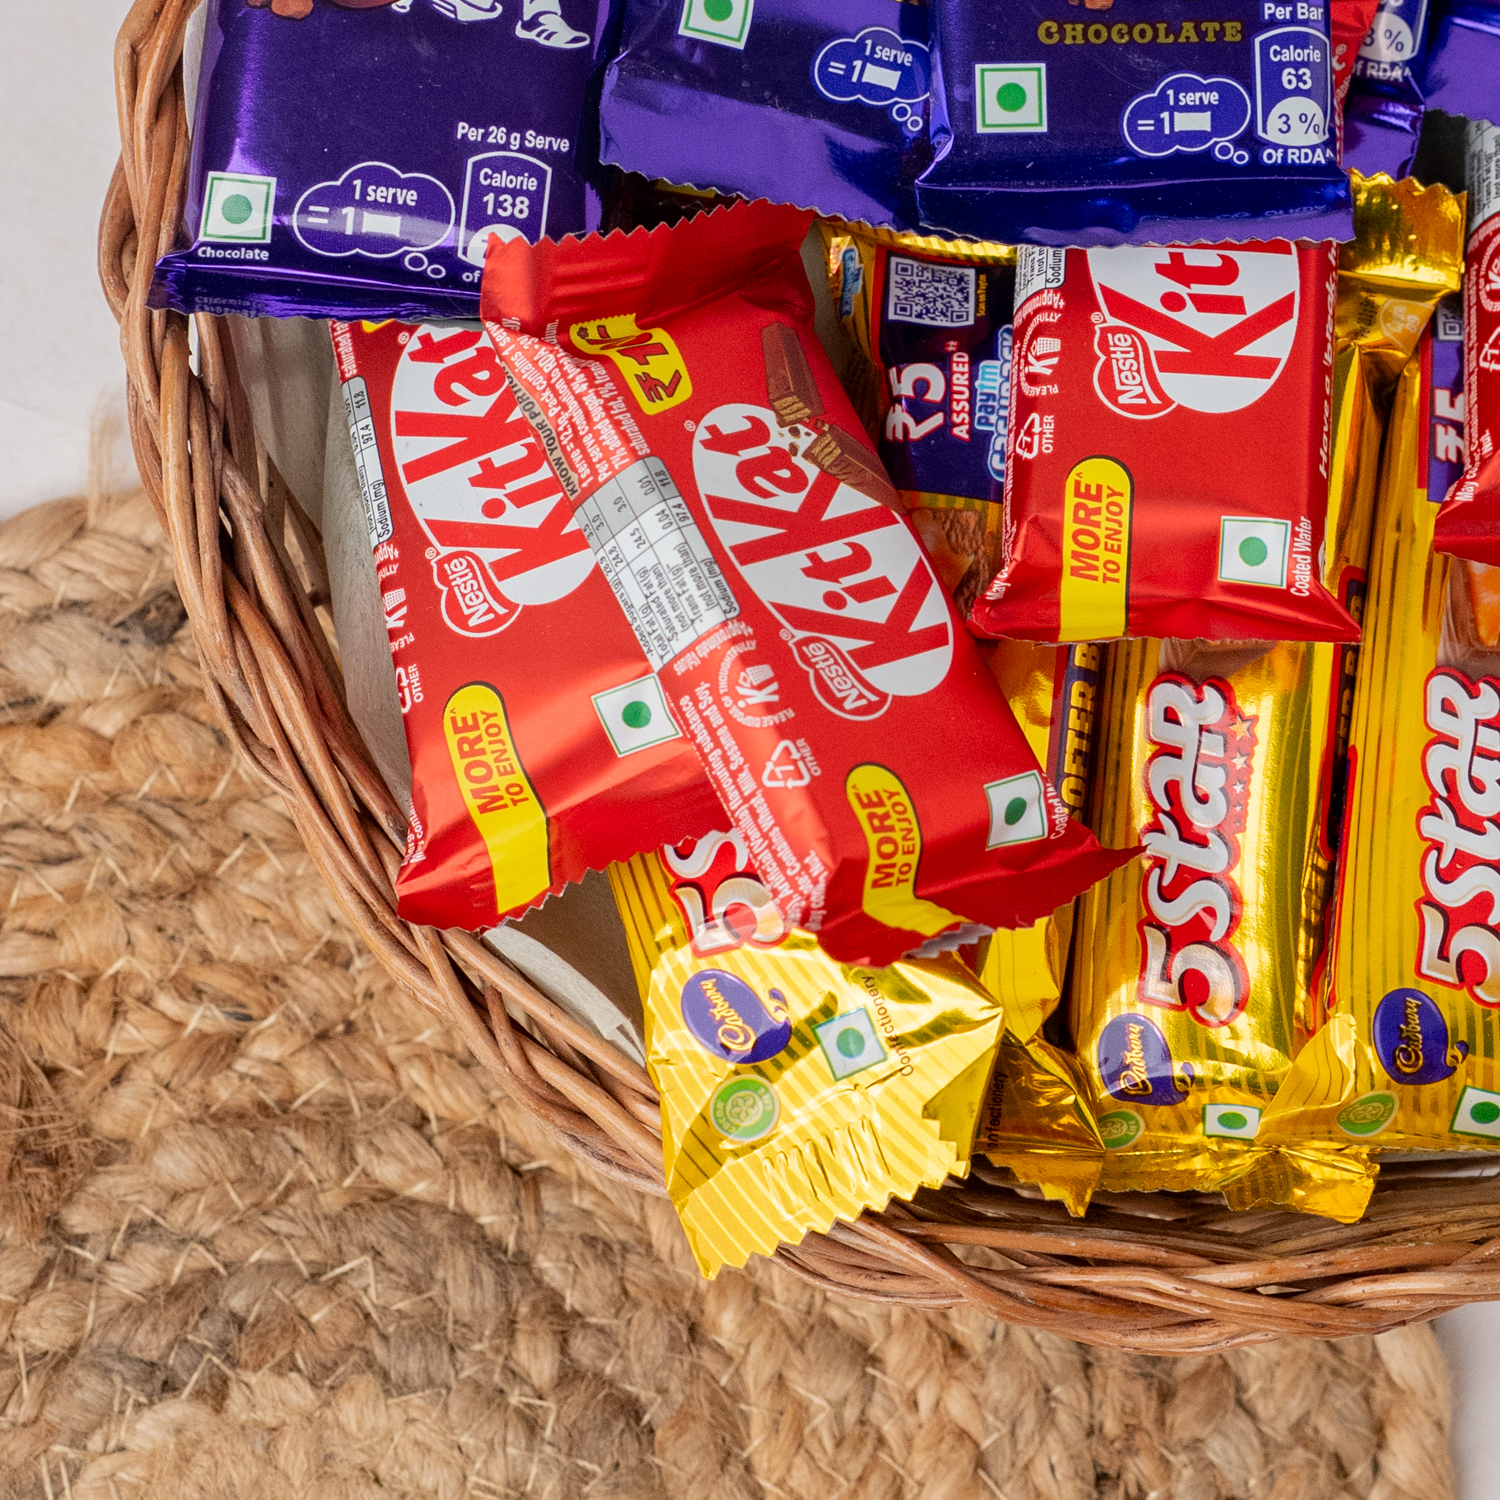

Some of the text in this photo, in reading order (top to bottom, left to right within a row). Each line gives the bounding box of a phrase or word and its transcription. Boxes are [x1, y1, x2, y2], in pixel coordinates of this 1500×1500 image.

[1263, 2, 1324, 20] Per Bar
[1037, 19, 1243, 46] CHOCOLATE
[876, 45, 913, 69] serve
[1269, 45, 1322, 63] Calorie
[1179, 89, 1219, 106] serve
[1281, 67, 1313, 90] 63
[456, 121, 571, 152] Per 26 g Serve
[1262, 148, 1283, 164] Of
[352, 179, 418, 206] 1 serve
[479, 167, 538, 191] Calorie
[482, 192, 530, 219] 138
[197, 246, 270, 261] Chocolate
[1047, 249, 1062, 284] Sodium
[462, 270, 481, 283] of
[1099, 245, 1298, 382] Kit
[511, 351, 561, 417] Pack contains
[555, 381, 613, 482] Per contribution
[593, 422, 623, 451] added
[616, 413, 651, 456] saturated
[1041, 414, 1055, 455] OTHER
[1319, 400, 1330, 479] Have
[394, 322, 594, 583] KitKat
[536, 420, 580, 497] KNOW YOUR
[370, 479, 386, 501] (mg)
[637, 474, 656, 497] 0.01
[374, 502, 391, 538] Sodium
[655, 508, 674, 531] 0.04
[671, 501, 691, 524] 97.4
[629, 526, 647, 550] 24.5
[699, 414, 952, 670] KitKat
[1102, 485, 1126, 585] TO ENJOY
[607, 545, 624, 569] 24.8
[1289, 516, 1313, 598] Coated Wafer
[701, 557, 737, 615] Sodium (mg)
[407, 663, 424, 703] OTHER
[680, 695, 714, 753] substance
[479, 710, 530, 809] TO ENJOY
[795, 737, 822, 777] OTHER
[716, 725, 802, 876] Contains Sesame
[889, 787, 921, 886] TO ENJOY
[700, 977, 758, 1052] Cadbury
[861, 975, 915, 1078] Confectionery
[1395, 996, 1424, 1075] Cadbury
[1119, 1021, 1154, 1096] Cadbury
